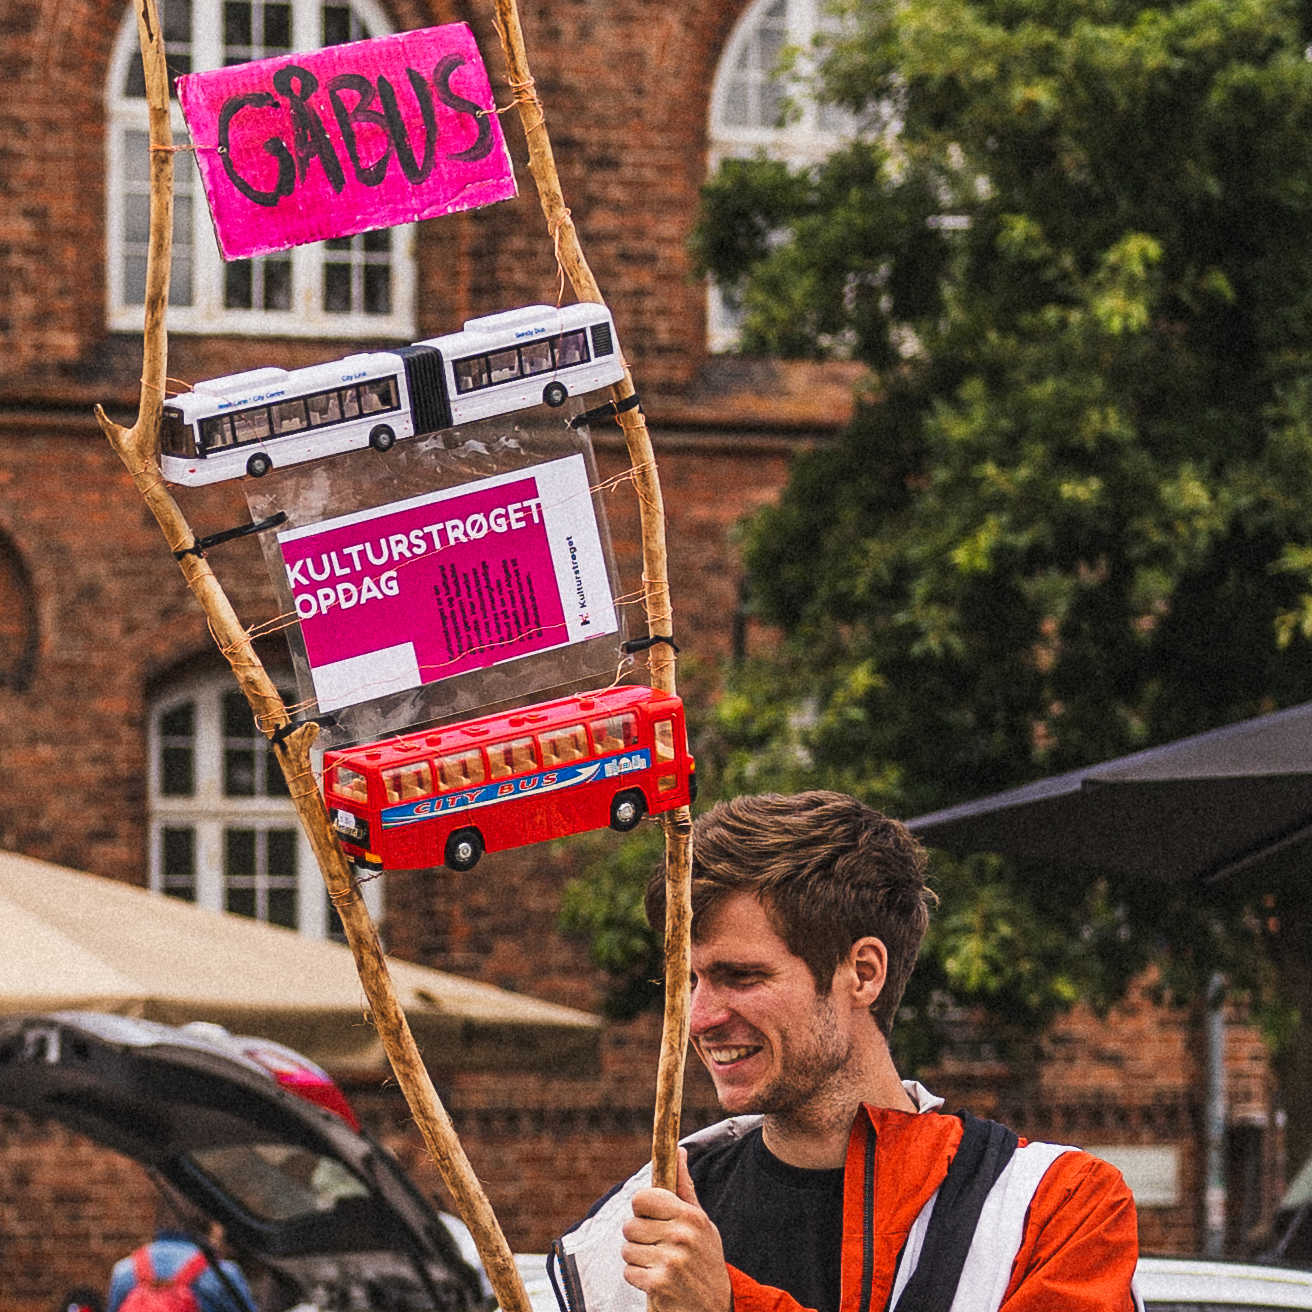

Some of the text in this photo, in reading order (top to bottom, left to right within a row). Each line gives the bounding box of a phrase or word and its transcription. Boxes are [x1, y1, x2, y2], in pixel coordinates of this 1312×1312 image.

[218, 52, 495, 208] GÅBUS
[285, 499, 544, 589] KULTURSTRØGET
[296, 569, 400, 619] OPDAG
[414, 773, 559, 815] CITY BUS
